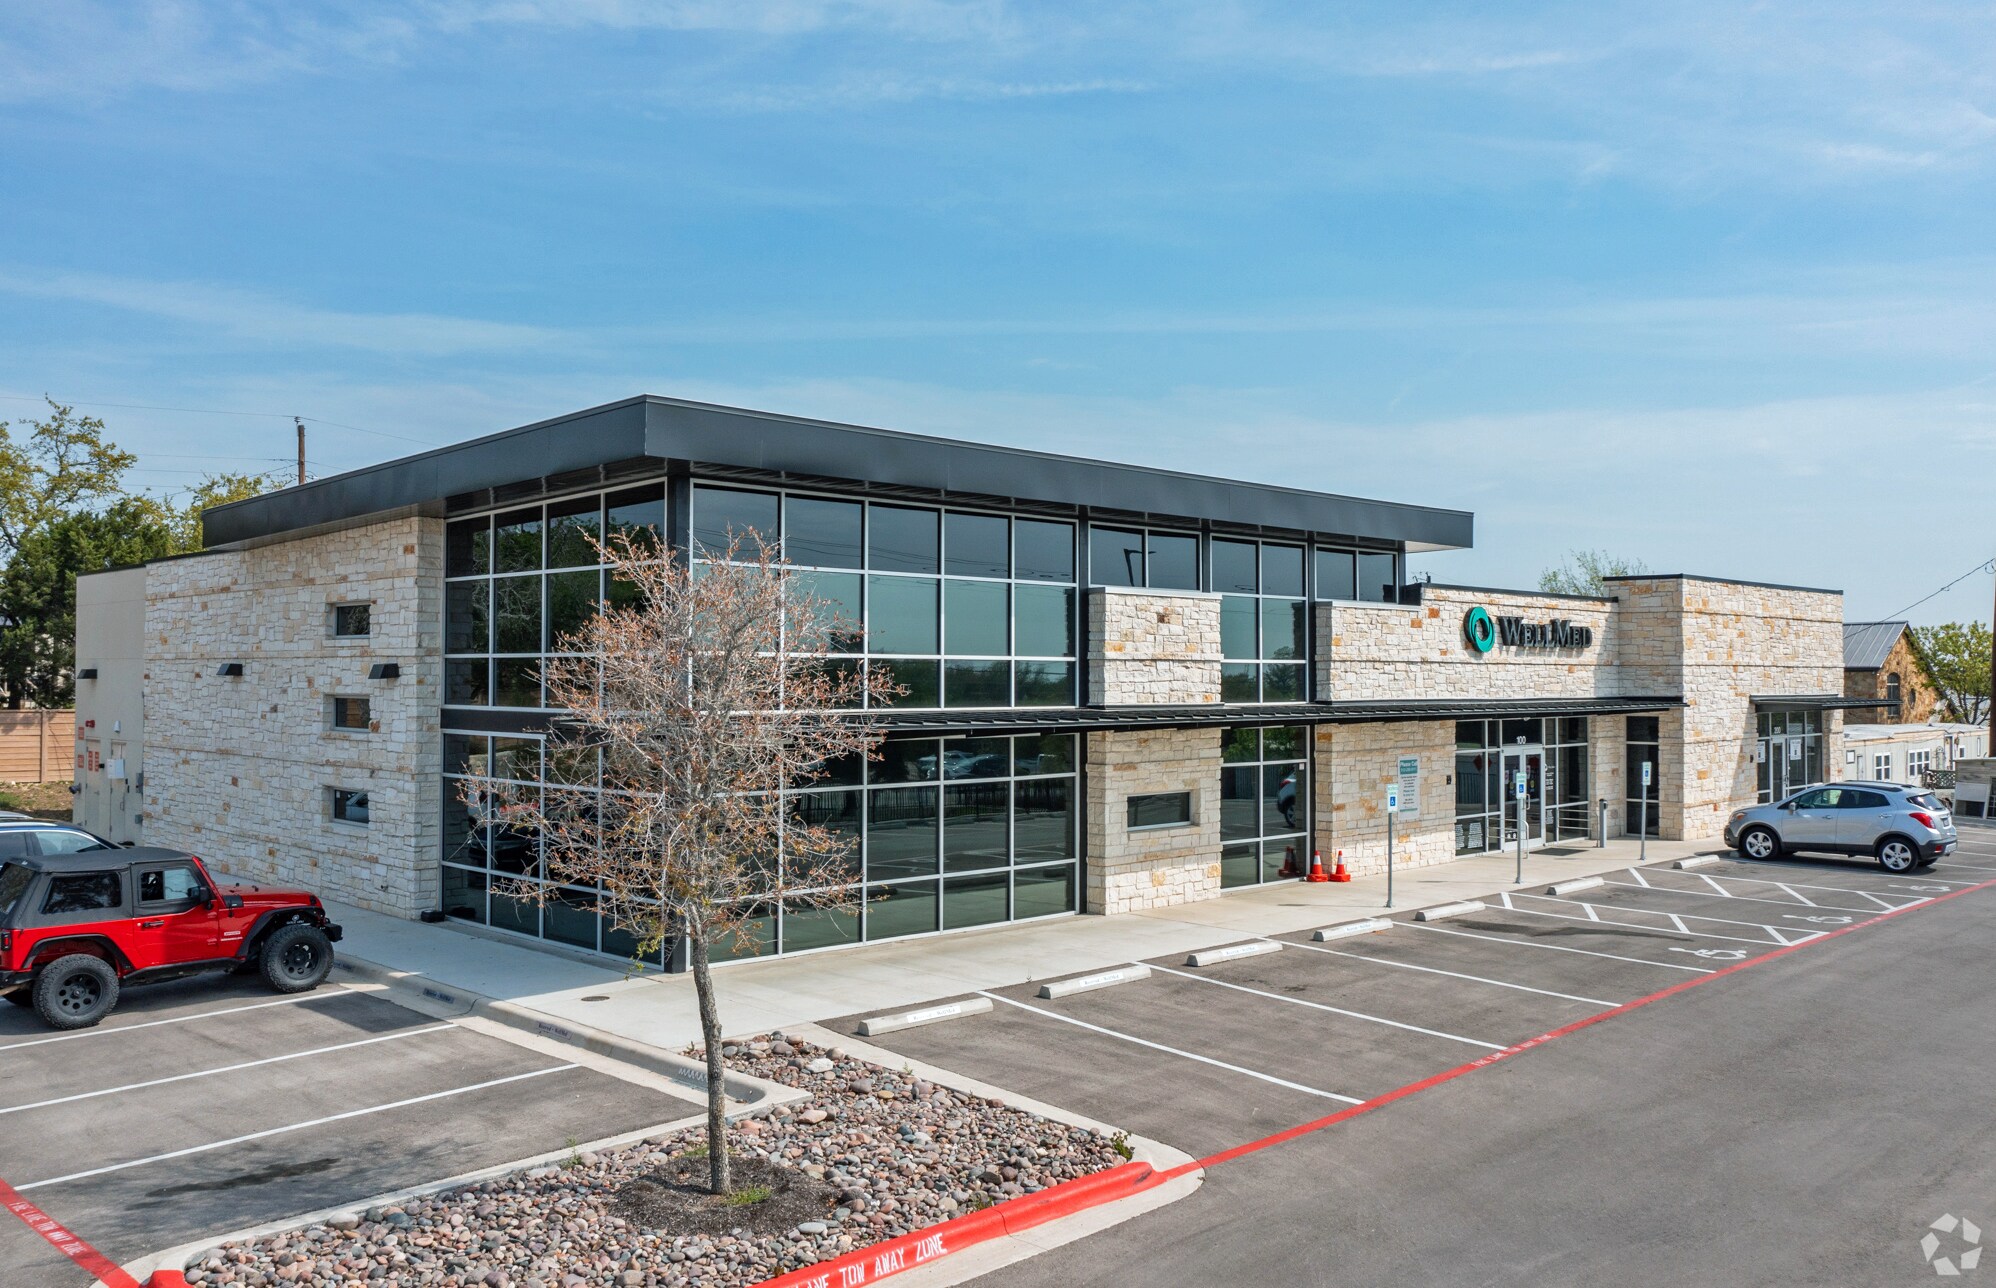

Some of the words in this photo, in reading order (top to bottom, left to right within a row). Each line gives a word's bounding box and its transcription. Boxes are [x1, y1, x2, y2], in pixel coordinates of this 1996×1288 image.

[1516, 735, 1527, 745] 100
[838, 1262, 865, 1288] TOW
[874, 1249, 905, 1277] AWAY
[915, 1232, 947, 1262] ZONE
